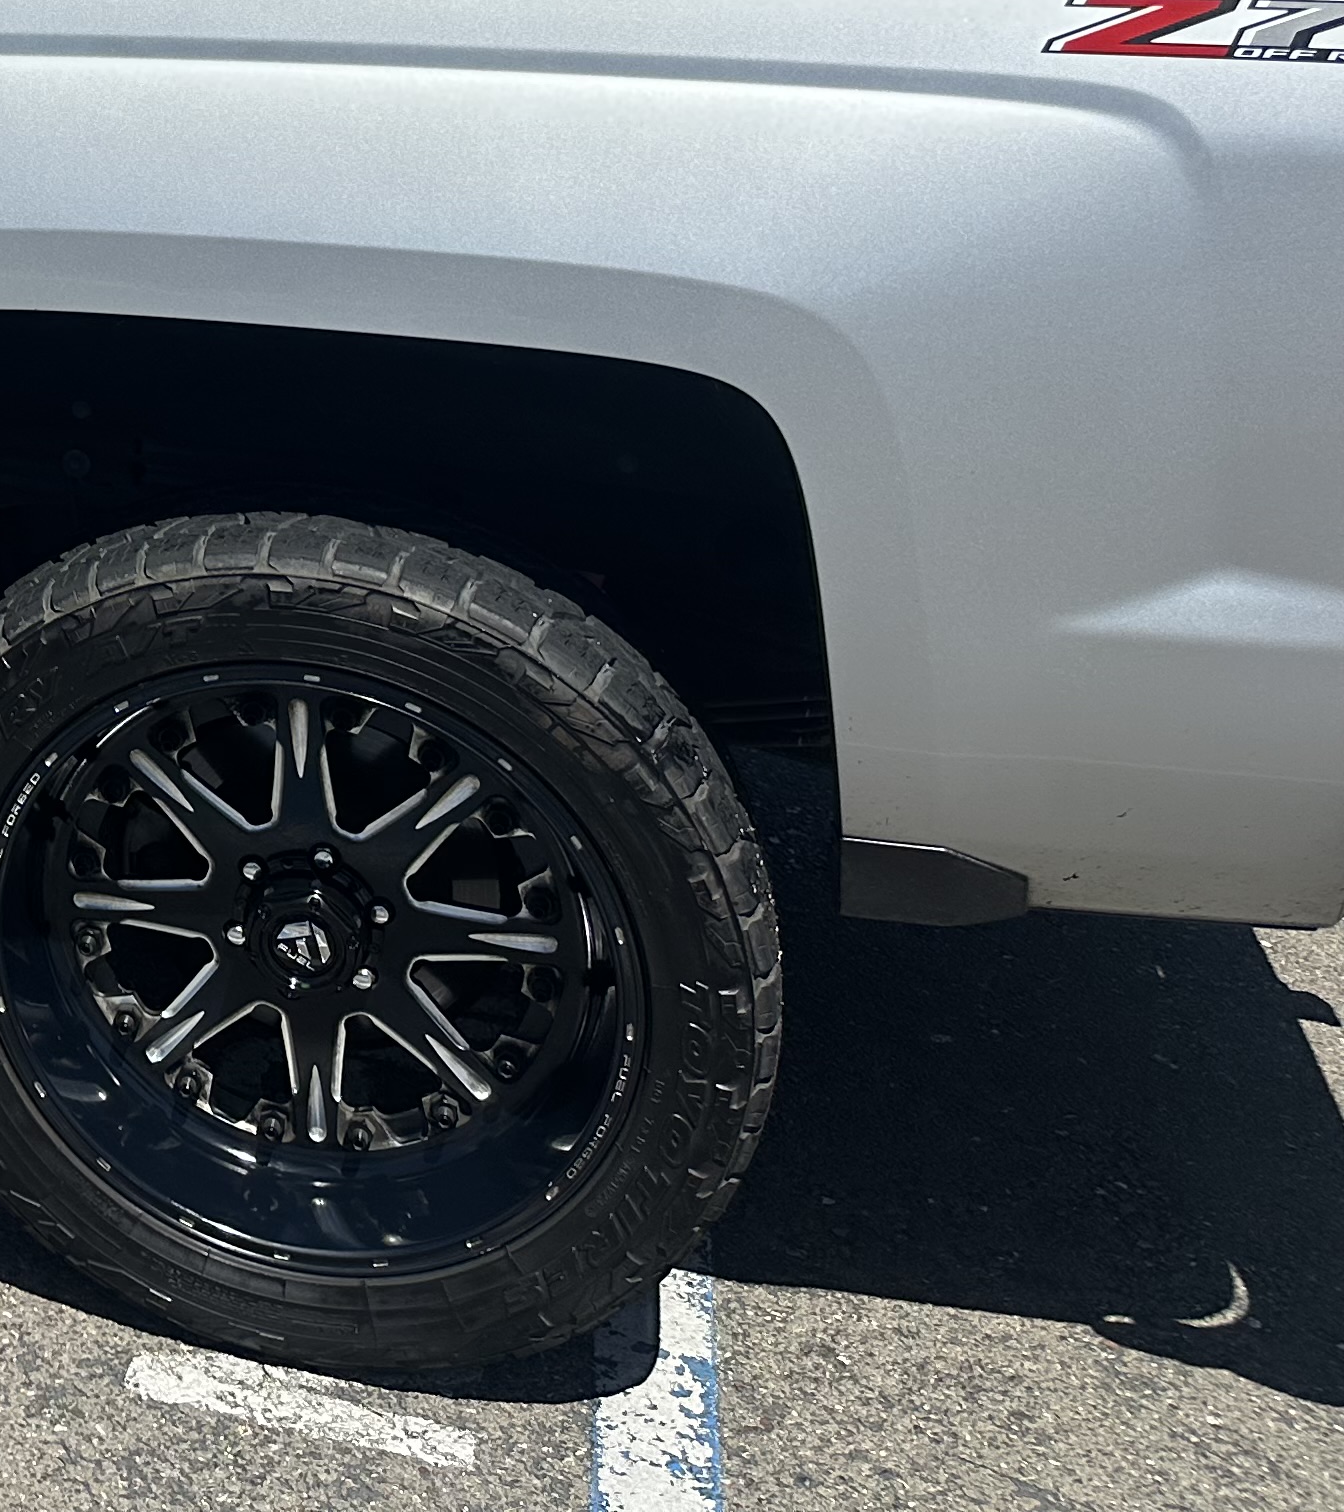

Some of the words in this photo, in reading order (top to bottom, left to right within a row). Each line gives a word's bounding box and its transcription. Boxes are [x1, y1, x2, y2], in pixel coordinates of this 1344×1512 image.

[1233, 47, 1317, 60] OFF
[1, 772, 41, 838] FORGED
[277, 942, 316, 972] FUEL
[610, 1054, 632, 1102] FUEL
